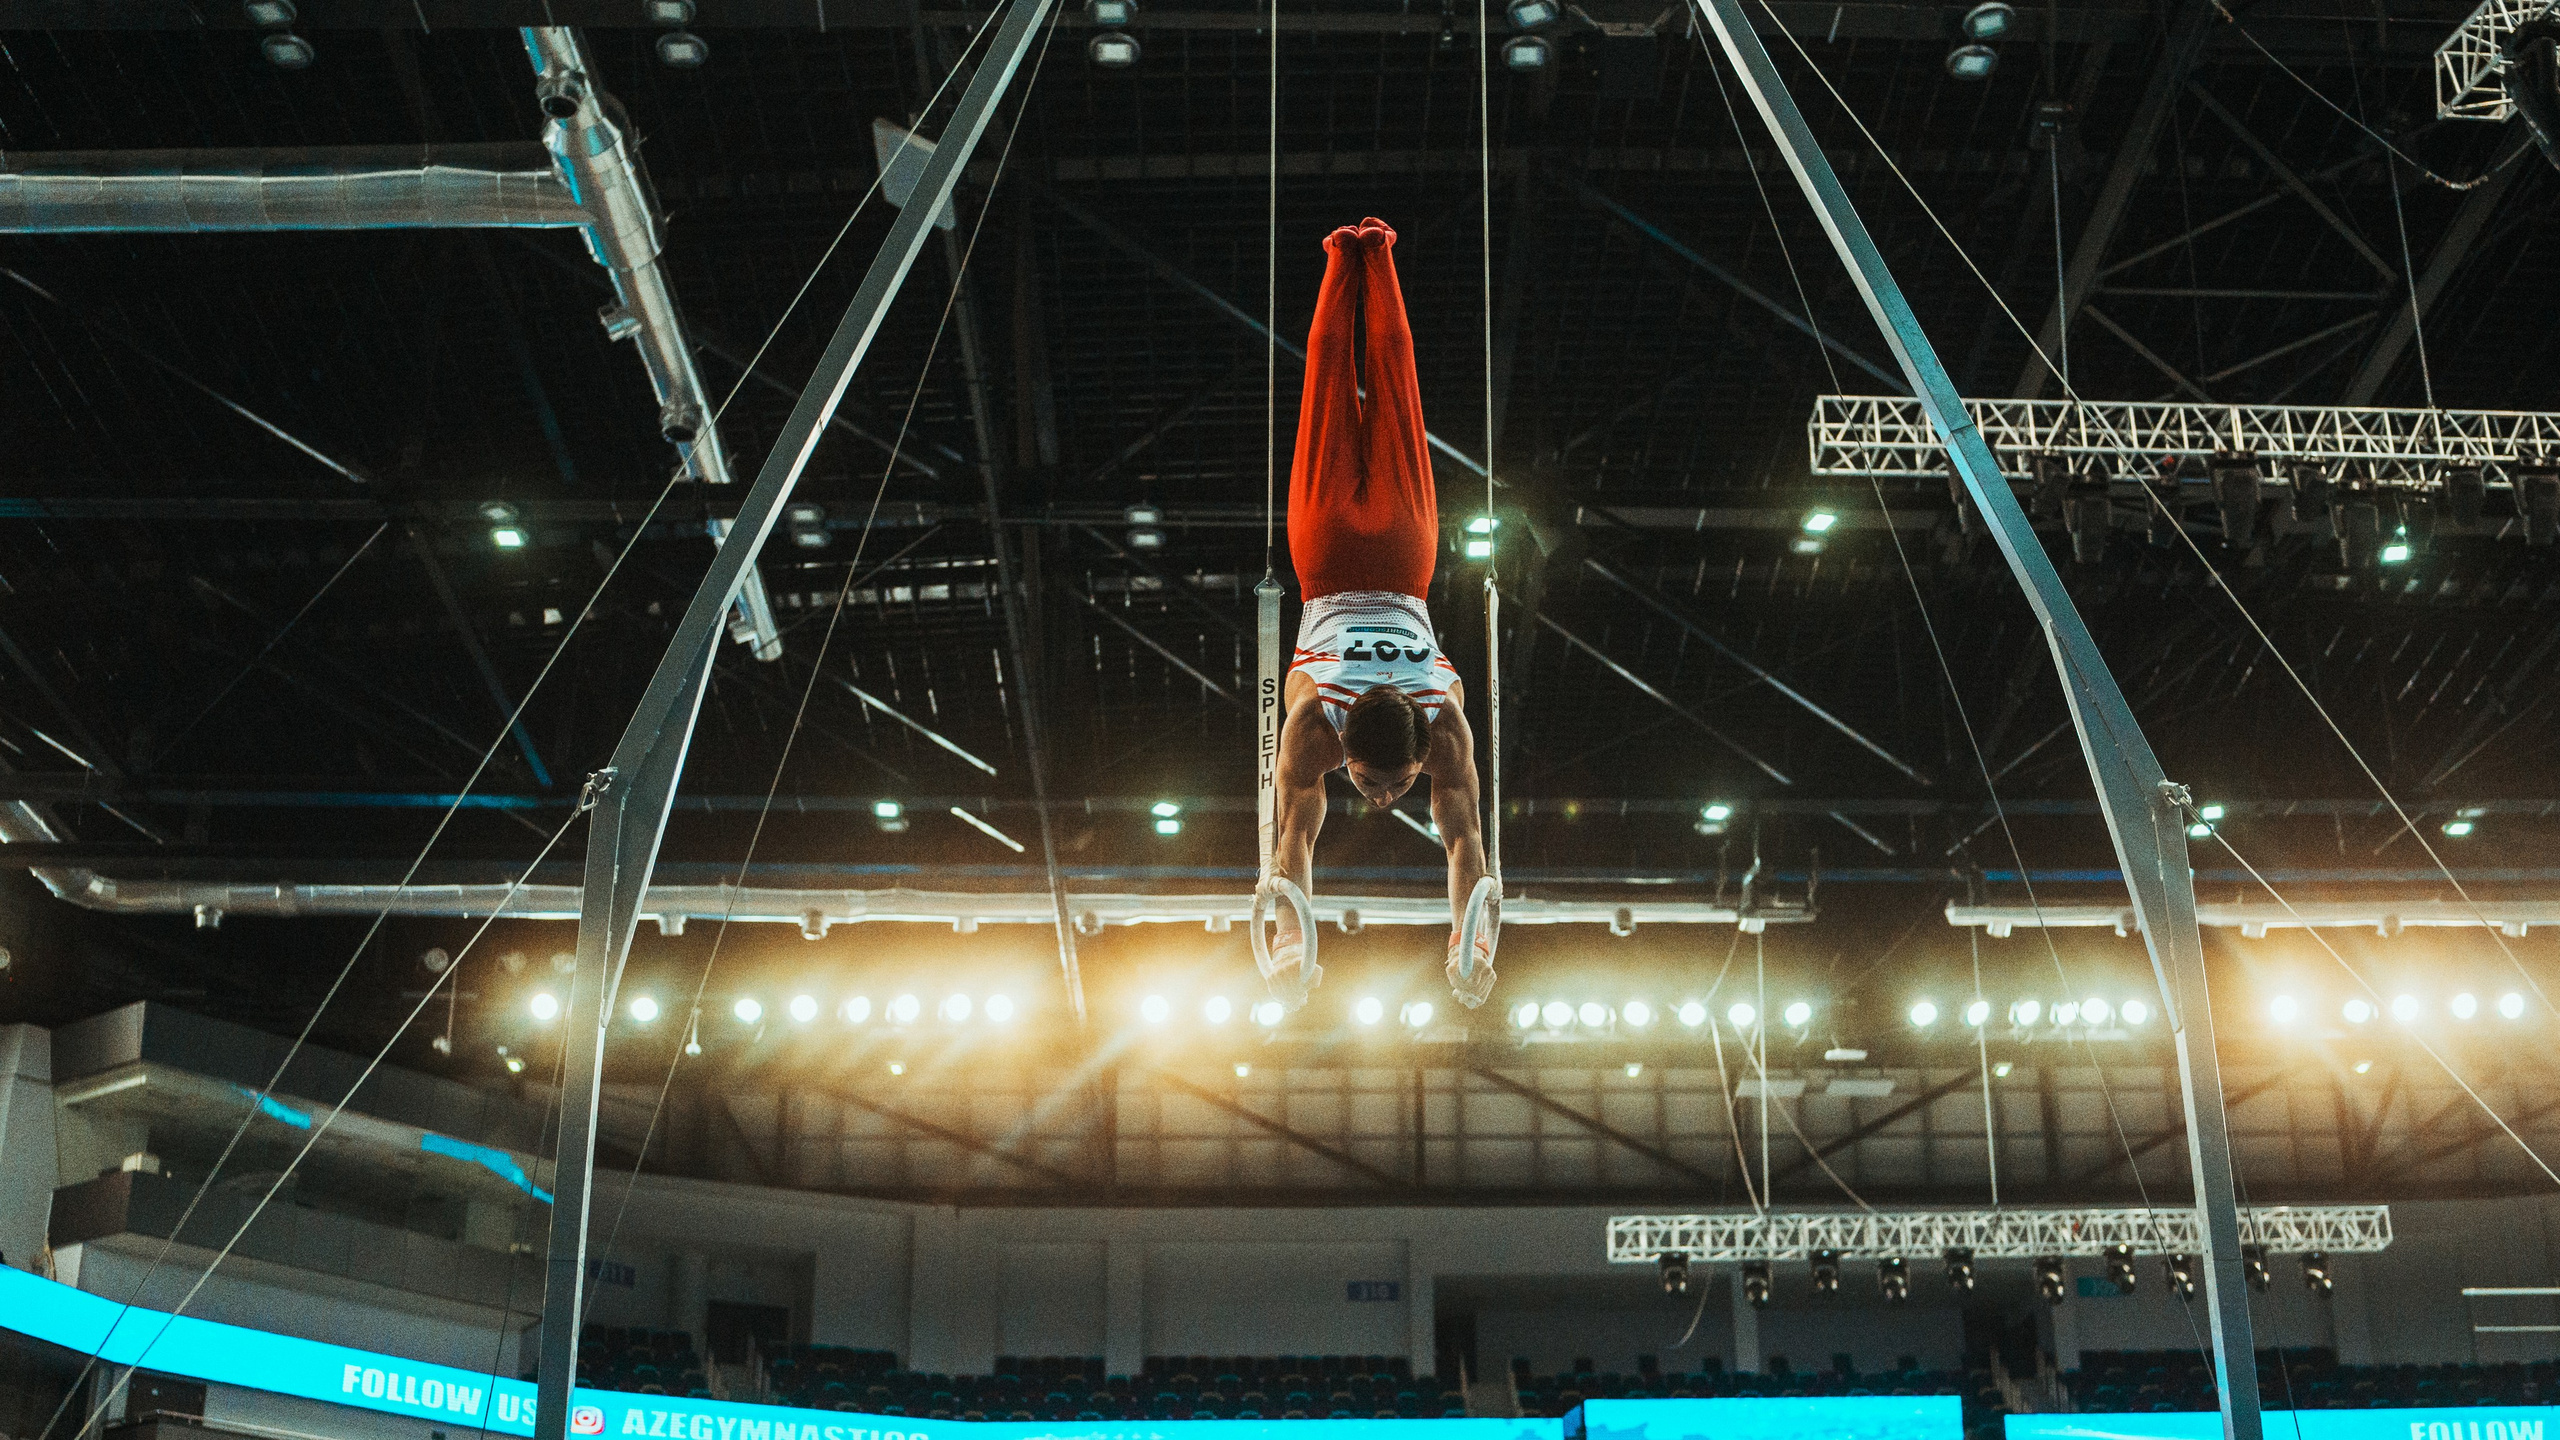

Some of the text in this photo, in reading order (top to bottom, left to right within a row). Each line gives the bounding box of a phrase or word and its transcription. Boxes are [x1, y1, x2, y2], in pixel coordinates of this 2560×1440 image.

[1260, 678, 1275, 789] SPIETH
[342, 1363, 482, 1416] FOLLOW
[497, 1392, 537, 1426] US
[2410, 1420, 2544, 1440] FOLLOW
